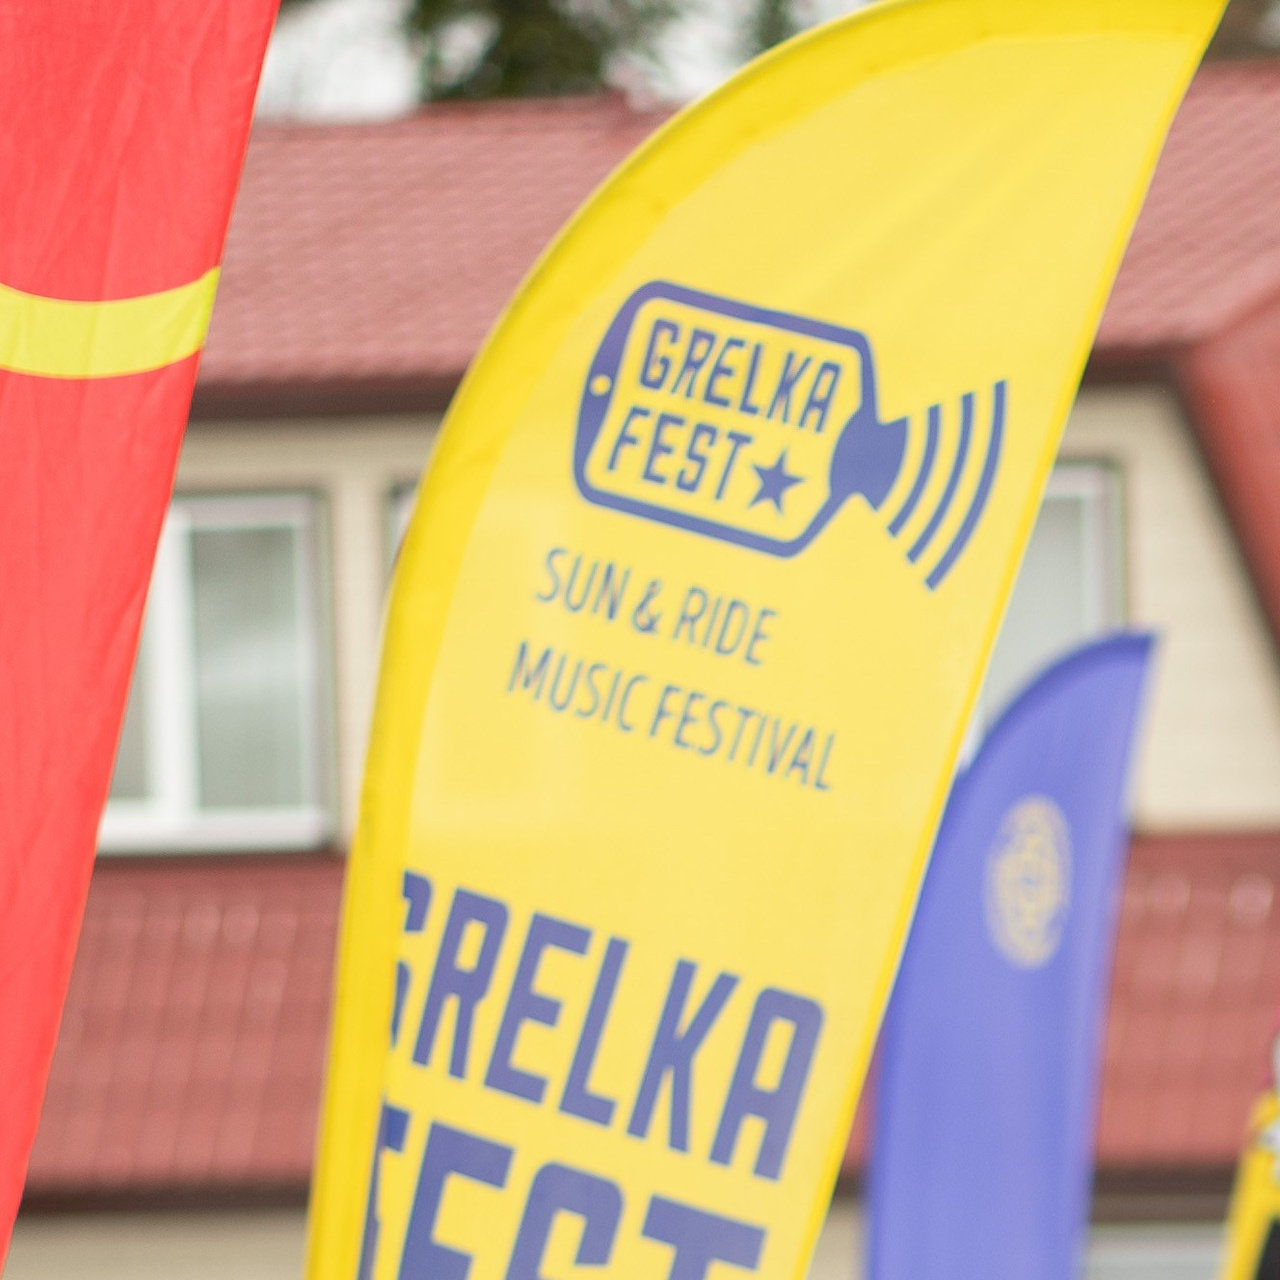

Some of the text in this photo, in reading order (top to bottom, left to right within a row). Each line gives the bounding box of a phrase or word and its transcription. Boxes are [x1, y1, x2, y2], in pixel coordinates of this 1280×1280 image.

[639, 318, 845, 434] GRELKA
[606, 406, 753, 501] FEST
[534, 546, 780, 668] SUN & RIDE
[506, 640, 837, 792] MUSIC FESTIVAL
